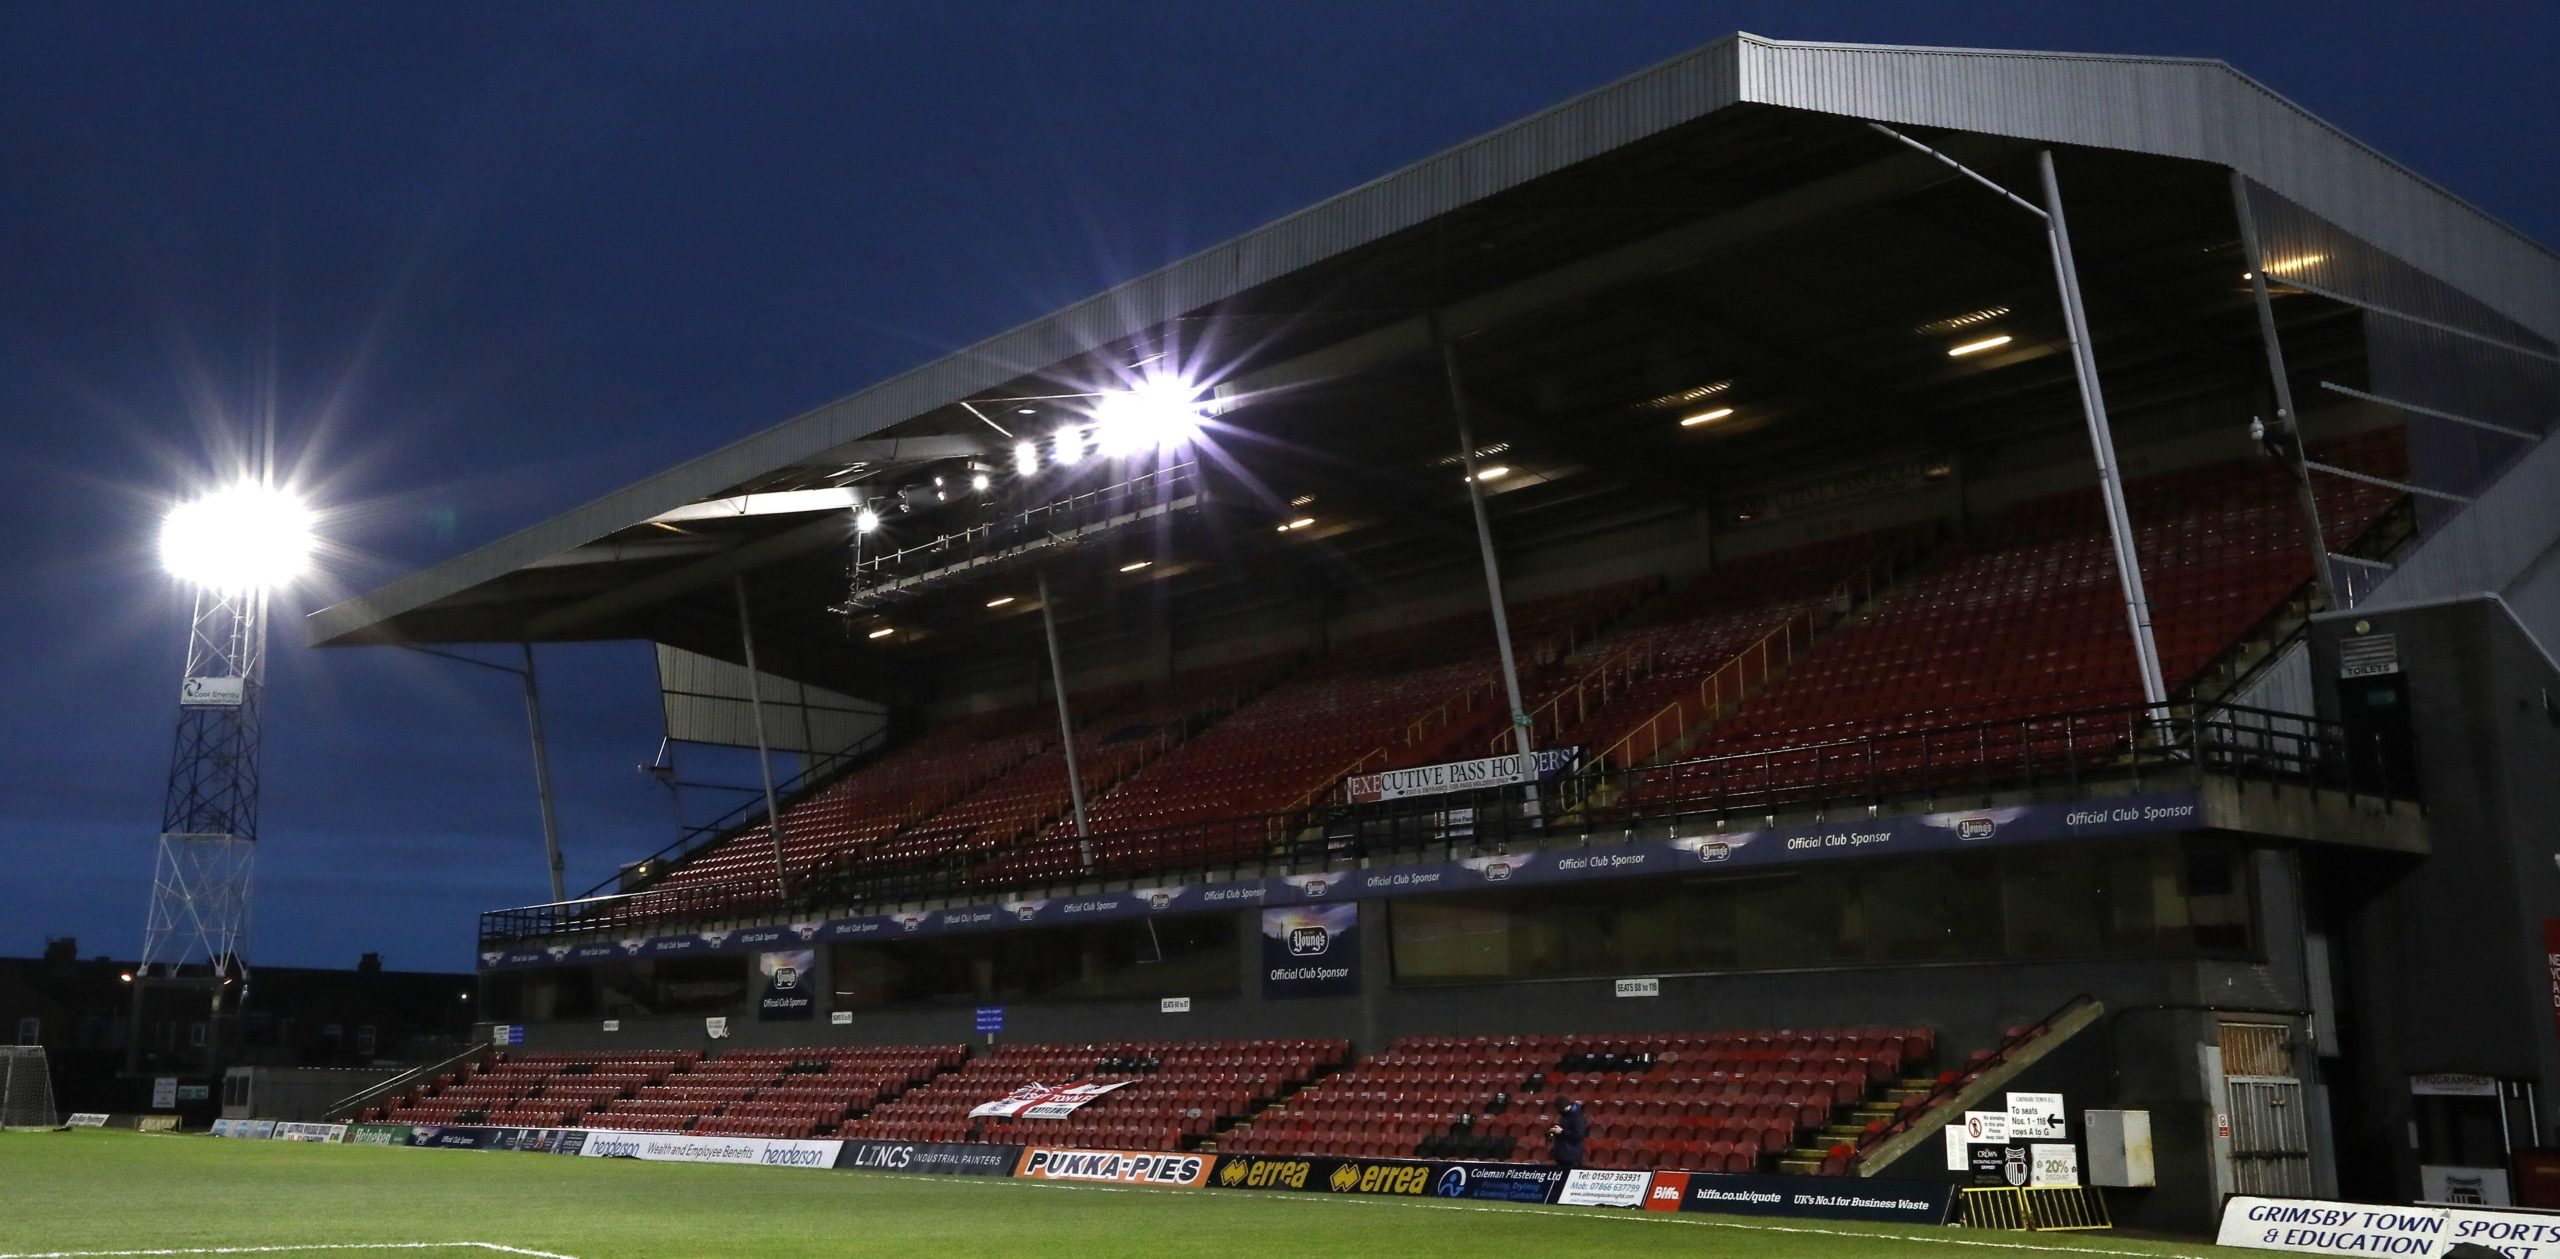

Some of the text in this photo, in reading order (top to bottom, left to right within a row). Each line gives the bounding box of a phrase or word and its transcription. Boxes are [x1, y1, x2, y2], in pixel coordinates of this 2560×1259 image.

[2347, 664, 2390, 675] TOILETS
[1352, 767, 1444, 795] EXECUTIVE
[1450, 761, 1486, 782] PASS
[2067, 806, 2193, 825] Official Club Sponsor
[1962, 819, 1992, 836] Young's
[1788, 833, 1890, 849] Official Club Sponsor
[1559, 855, 1644, 869] Official Club Sponsor
[1368, 873, 1439, 887] Official Club Sponsor
[1205, 889, 1265, 900] Official Club Sponsor
[1064, 902, 1117, 912] Official Club Sponsor
[1294, 930, 1325, 952] Young's
[1271, 968, 1348, 980] Official Club Sponsor
[1618, 984, 1633, 992] SEATS
[1649, 982, 1657, 991] 118
[764, 1000, 779, 1008] Official
[790, 998, 808, 1008] Sponsor
[2416, 1075, 2489, 1086] PROGRAMMES
[2012, 1106, 2038, 1115] To seats
[352, 1128, 392, 1144] Heineken
[2045, 1128, 2049, 1136] G
[590, 1136, 639, 1156] henderson
[648, 1142, 753, 1158] Wealth and Employee Benefits
[761, 1142, 822, 1165] henderson
[855, 1146, 1001, 1168] LINCS INDUSTRIAL PAINTERS
[1978, 1150, 1997, 1158] CROWN
[1025, 1150, 1202, 1184] PUKKA-PIES
[2045, 1160, 2068, 1173] 20%
[1471, 1168, 1563, 1182] Coleman Plastering Ltd
[1579, 1172, 1641, 1182] Tel: 01507 363931
[1570, 1182, 1640, 1192] Mob: 07866 637799
[1653, 1186, 1679, 1200] Biffa
[1697, 1189, 1781, 1204] biffa.co.uk/quote
[1794, 1195, 1929, 1210] UK's No.1 for Business Waste
[2248, 1205, 2560, 1243] GRIMSBY TOWN SPORTS
[2263, 1228, 2278, 1244] &
[2285, 1229, 2433, 1255] EDUCATION
